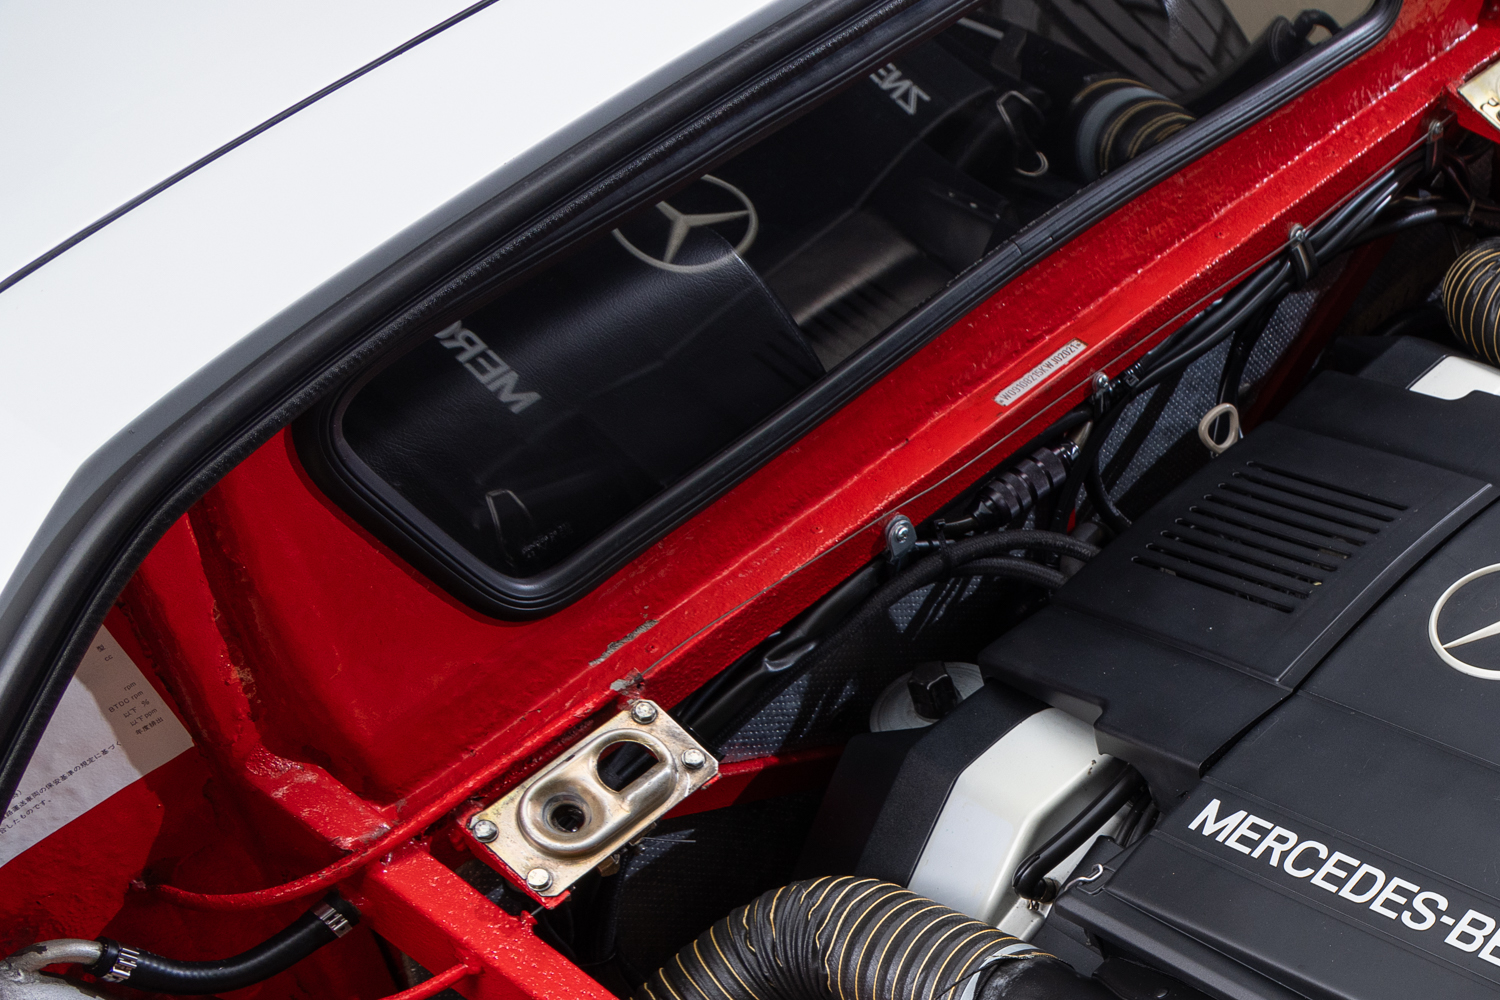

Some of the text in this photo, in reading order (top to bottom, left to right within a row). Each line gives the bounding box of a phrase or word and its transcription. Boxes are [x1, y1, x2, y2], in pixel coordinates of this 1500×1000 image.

[124, 682, 137, 692] rpm
[131, 690, 144, 701] rpm
[144, 708, 158, 719] ppm
[3, 741, 122, 819] 路運送車両の保安基準の規定に基づく
